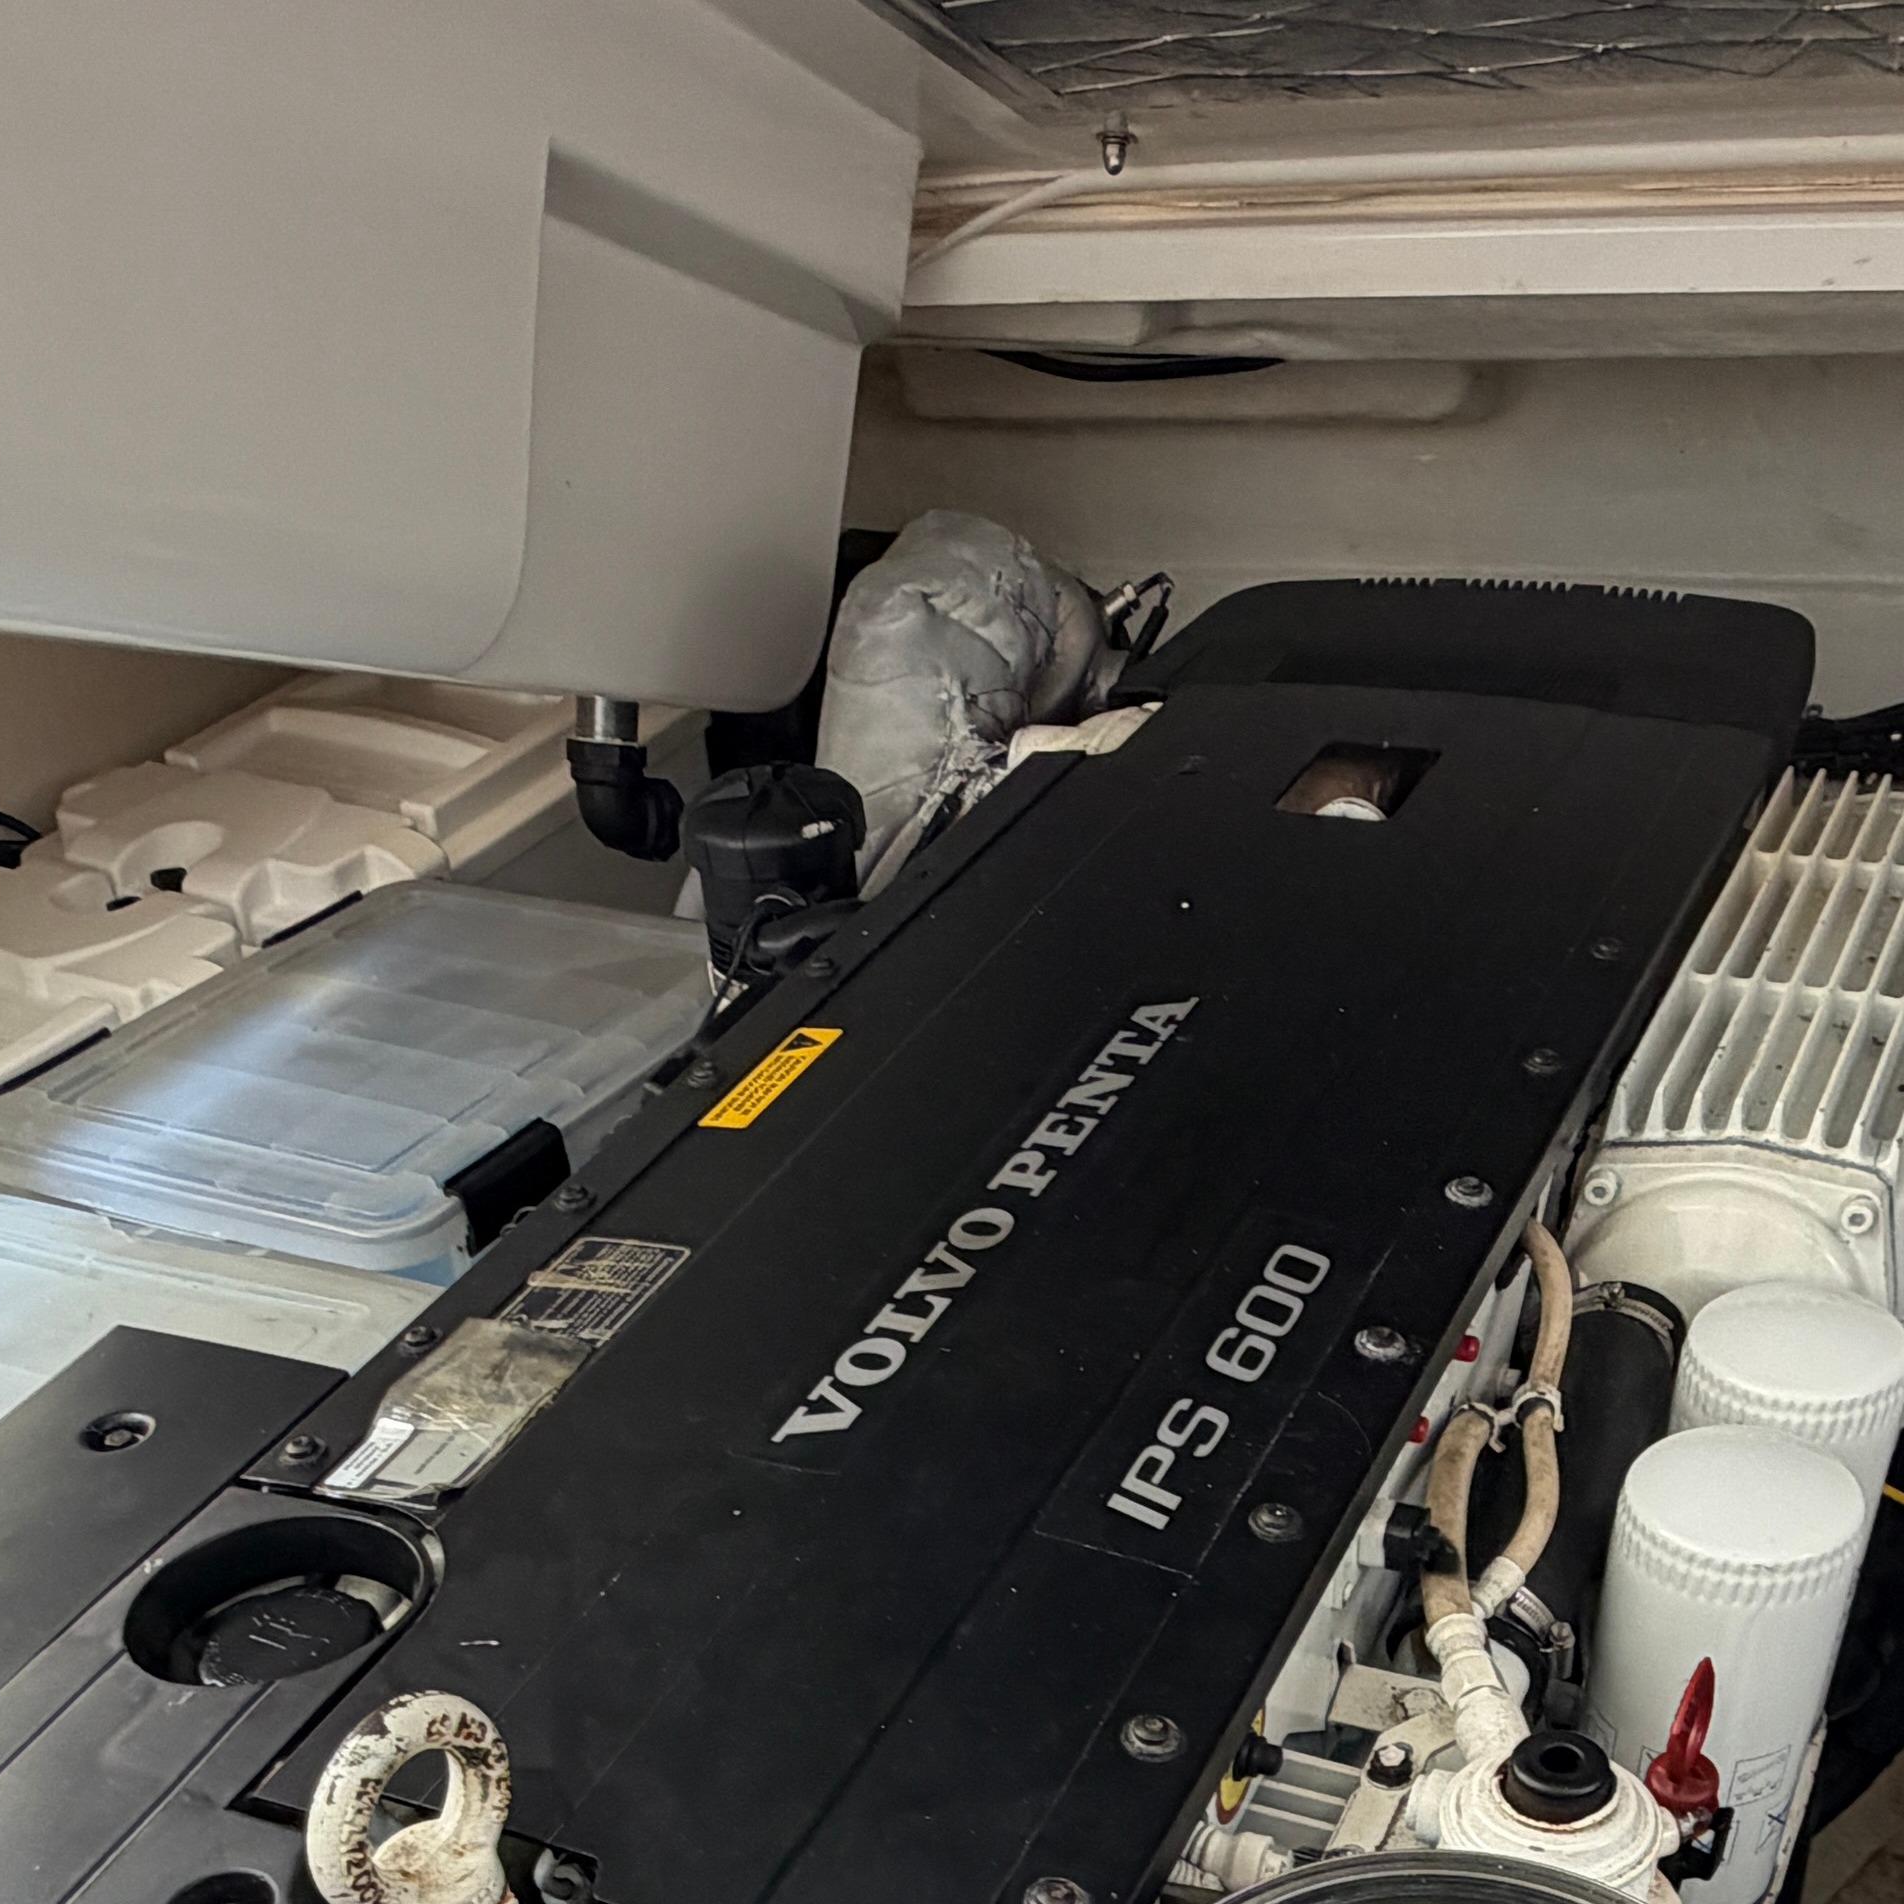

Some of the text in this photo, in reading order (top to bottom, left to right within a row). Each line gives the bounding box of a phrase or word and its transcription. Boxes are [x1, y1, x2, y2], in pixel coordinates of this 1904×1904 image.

[770, 996, 1200, 1443] VOLVO PENTA
[1106, 1243, 1331, 1531] IPS 600
